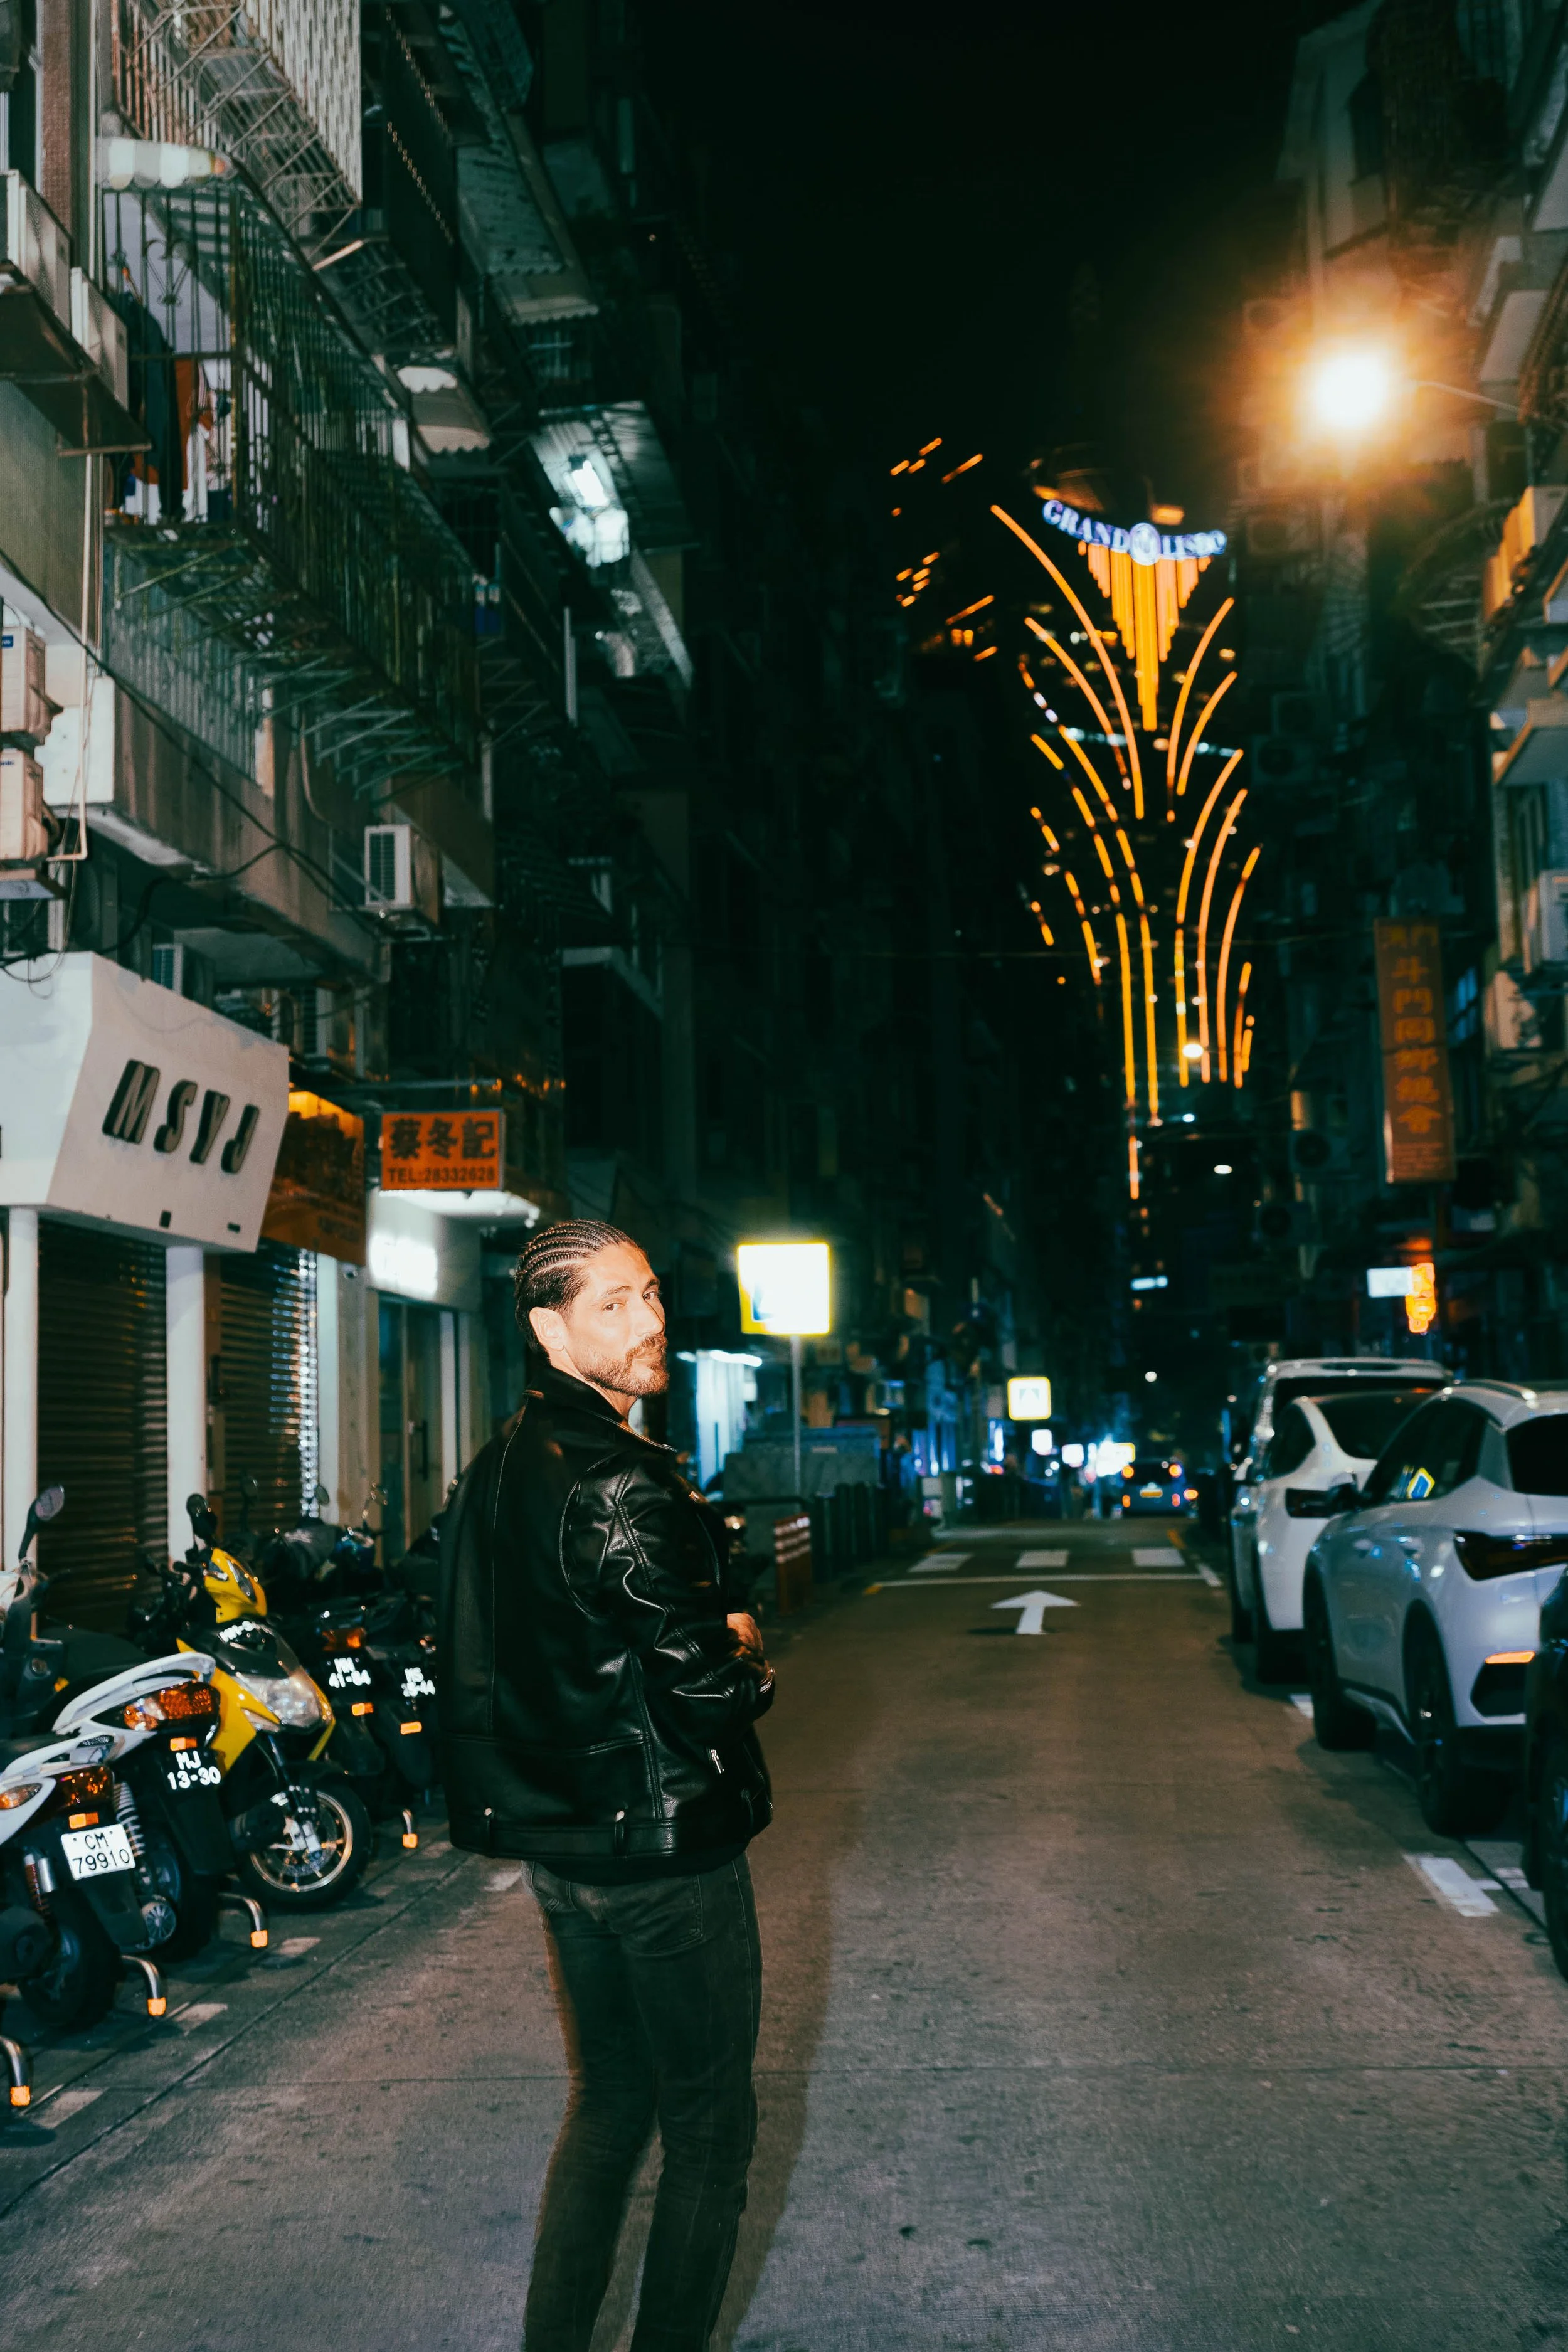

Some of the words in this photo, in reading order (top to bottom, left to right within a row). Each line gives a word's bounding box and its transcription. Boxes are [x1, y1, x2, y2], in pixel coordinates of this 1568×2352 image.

[1042, 499, 1129, 553] GRAND
[102, 1058, 259, 1174] MSYJ
[176, 1751, 201, 1770] MJ
[167, 1766, 221, 1790] 13-30
[85, 1832, 109, 1850] CM
[72, 1849, 130, 1874] 79910
